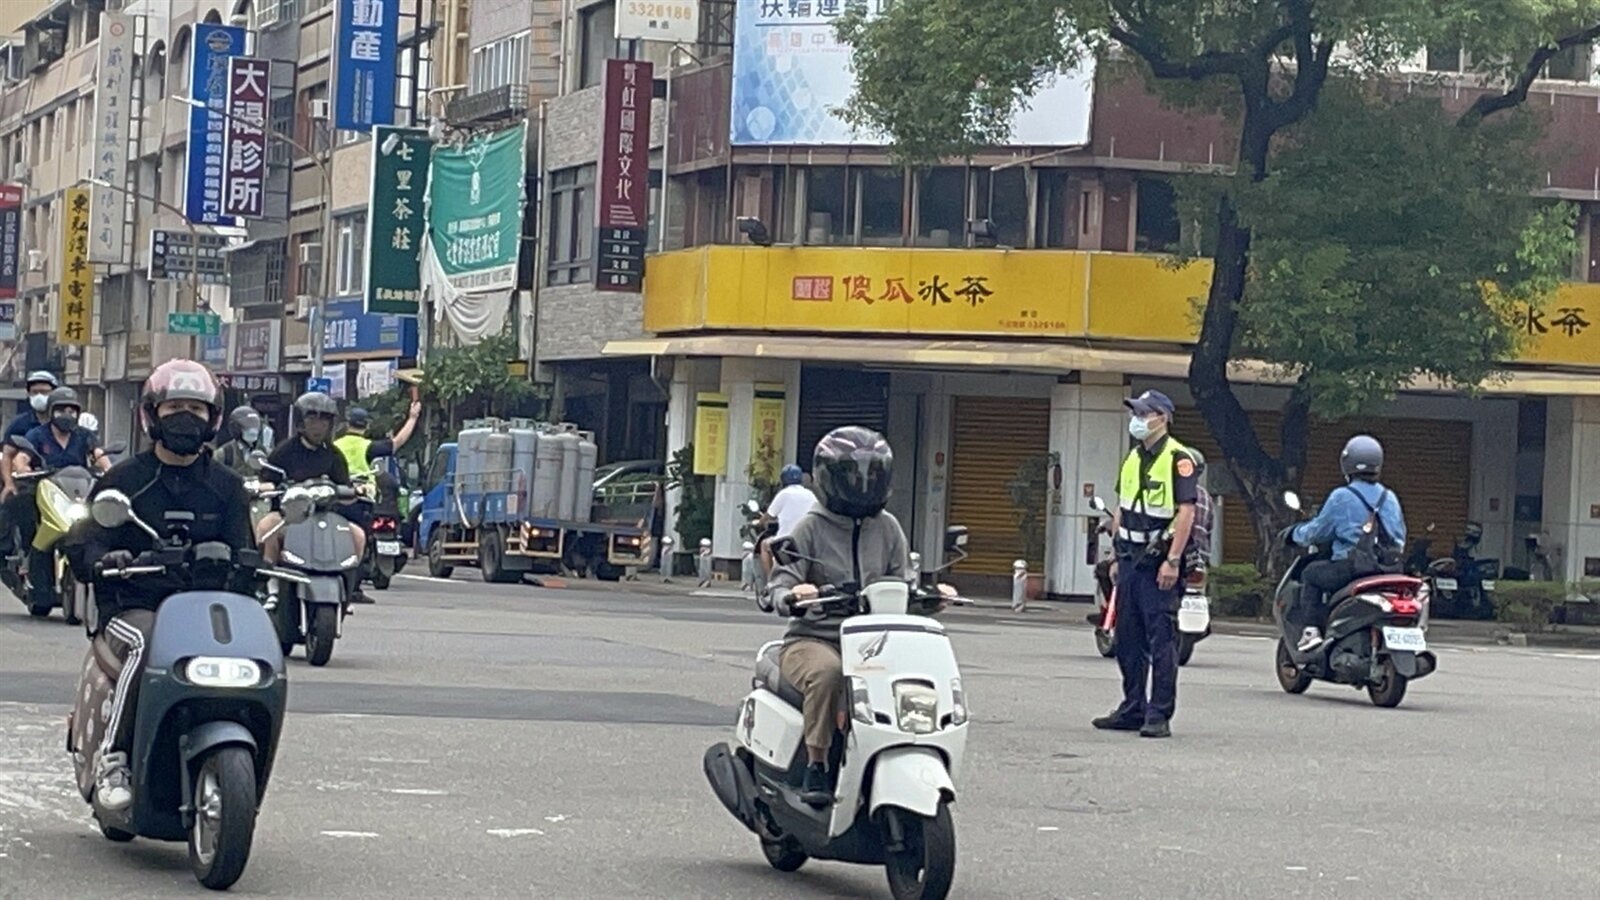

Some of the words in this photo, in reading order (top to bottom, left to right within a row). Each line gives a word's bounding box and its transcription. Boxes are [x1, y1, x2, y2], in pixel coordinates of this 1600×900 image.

[228, 63, 265, 213] 大福診所
[391, 142, 414, 250] 七里茶莊
[842, 274, 995, 307] 傻瓜冰茶
